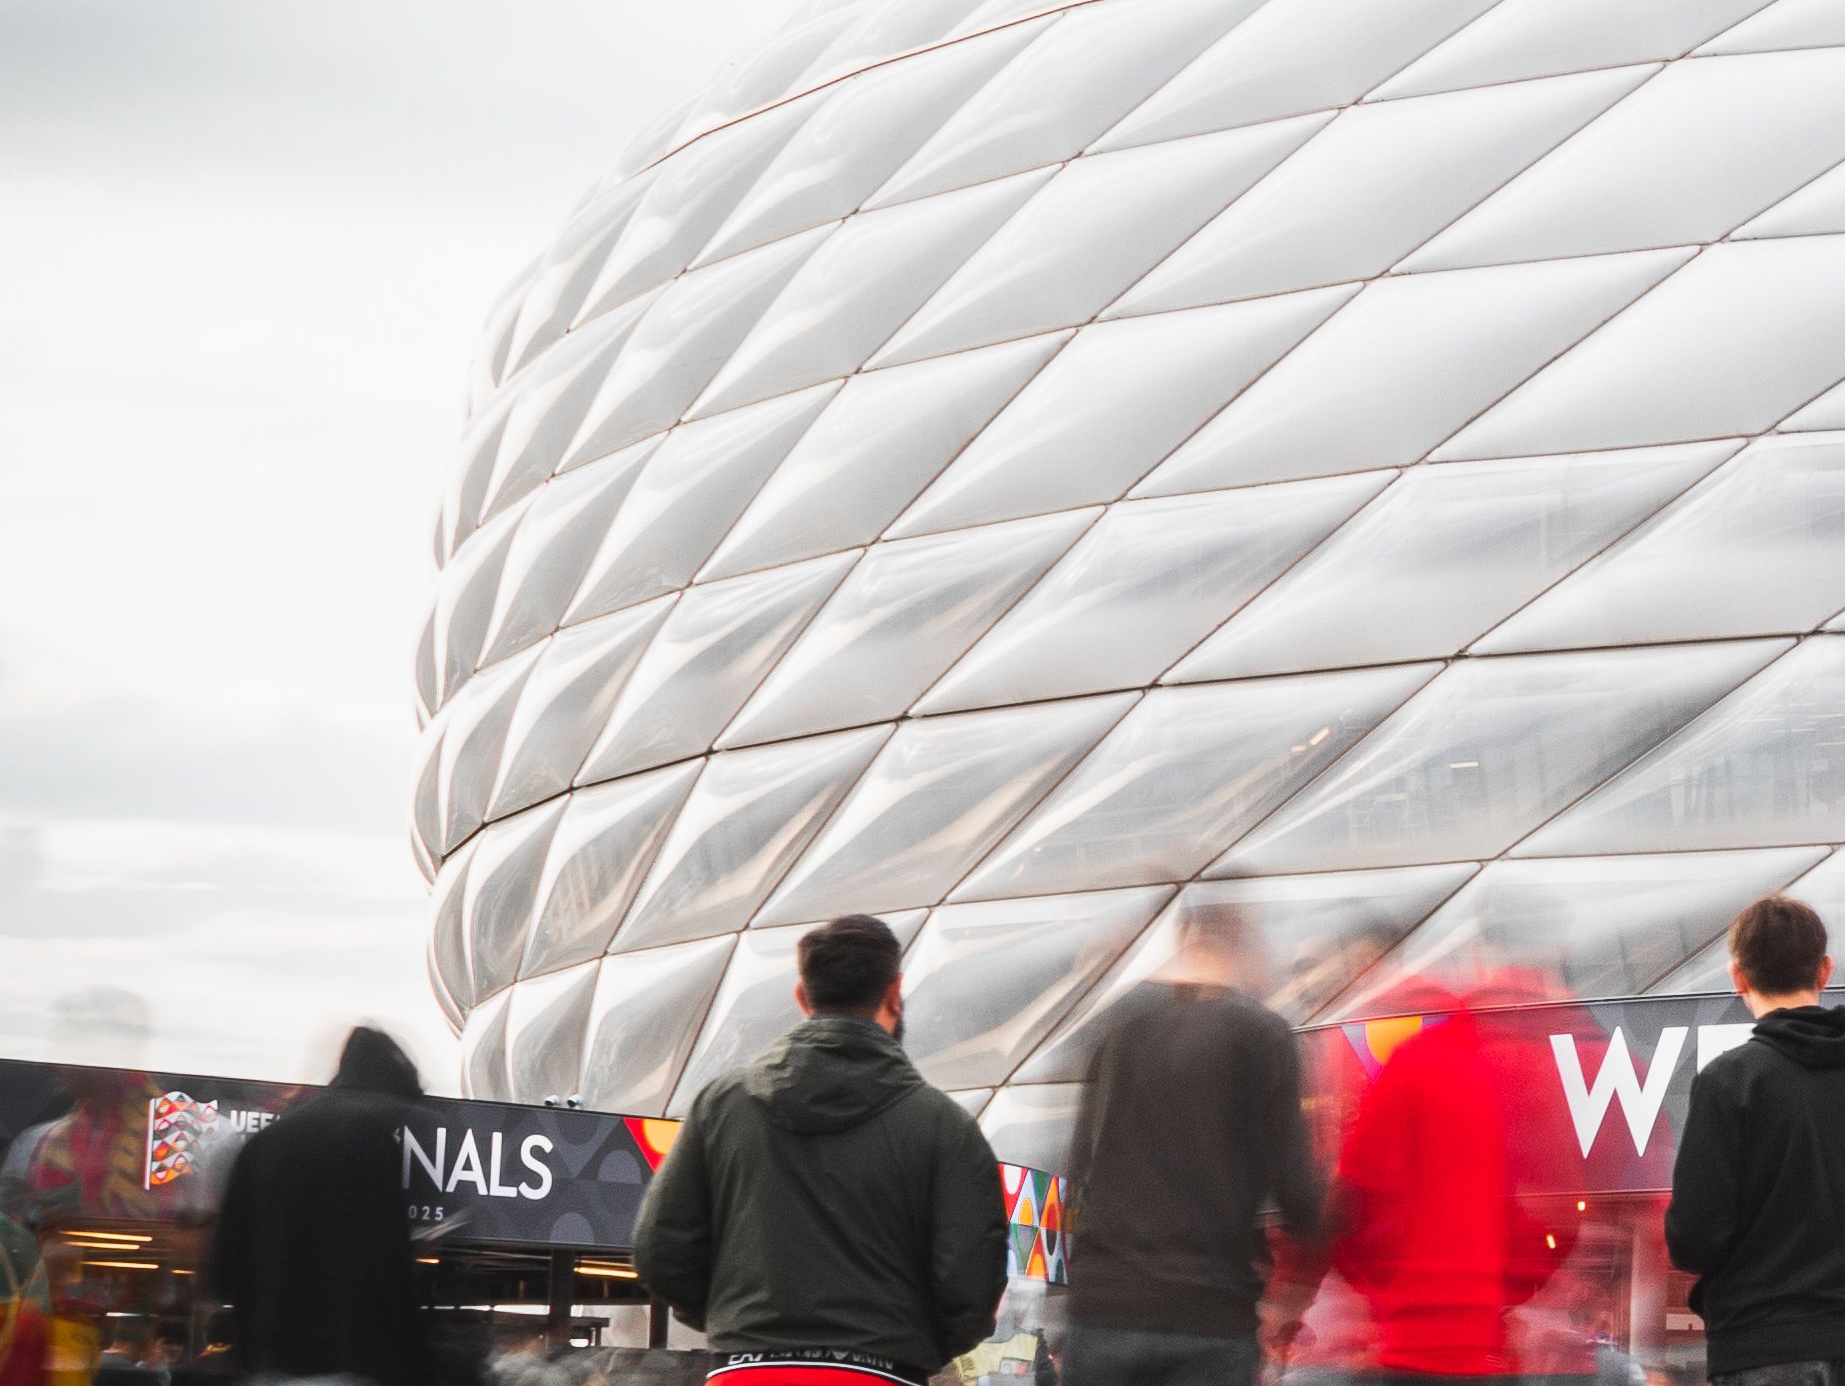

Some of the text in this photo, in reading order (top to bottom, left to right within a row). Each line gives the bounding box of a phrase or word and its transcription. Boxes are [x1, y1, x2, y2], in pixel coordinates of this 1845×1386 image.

[230, 1110, 281, 1134] UEF
[394, 1125, 554, 1201] NALS
[407, 1204, 445, 1222] 025
